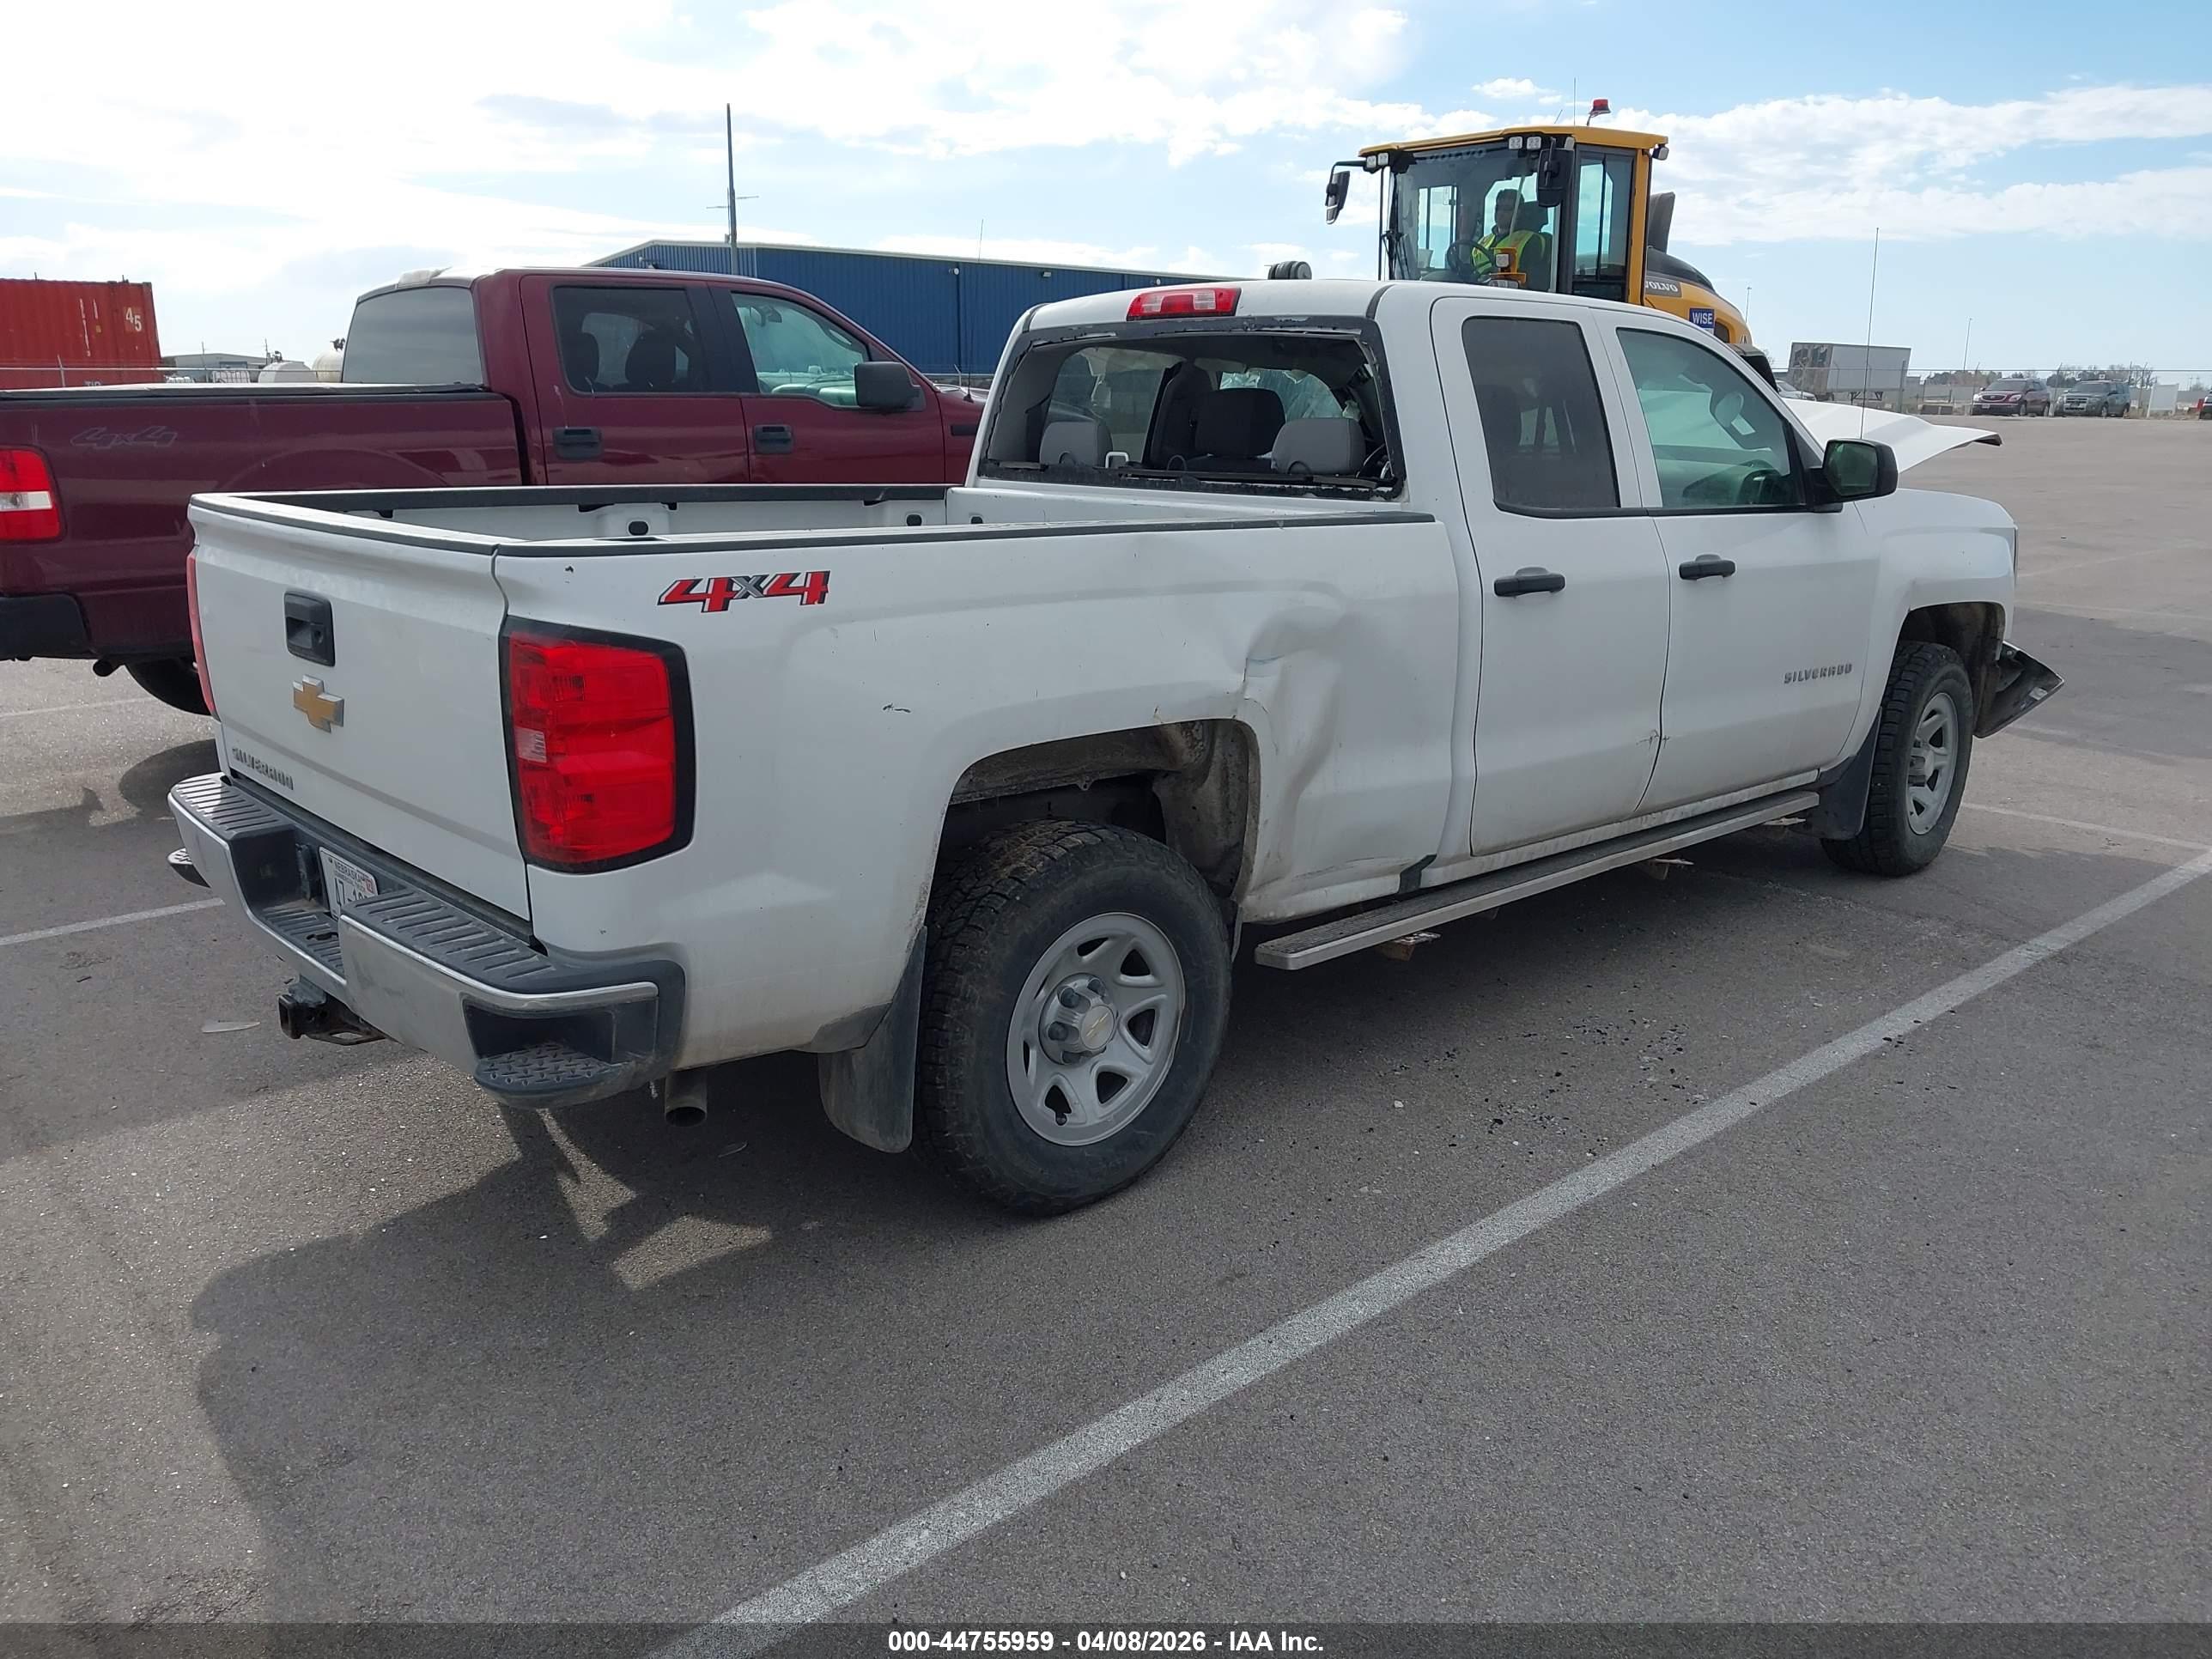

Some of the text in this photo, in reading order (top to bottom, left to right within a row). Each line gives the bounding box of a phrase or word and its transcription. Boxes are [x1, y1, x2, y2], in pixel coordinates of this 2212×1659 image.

[125, 307, 143, 331] 45
[1692, 312, 1713, 325] WISE
[1784, 663, 1852, 684] SILVERADO
